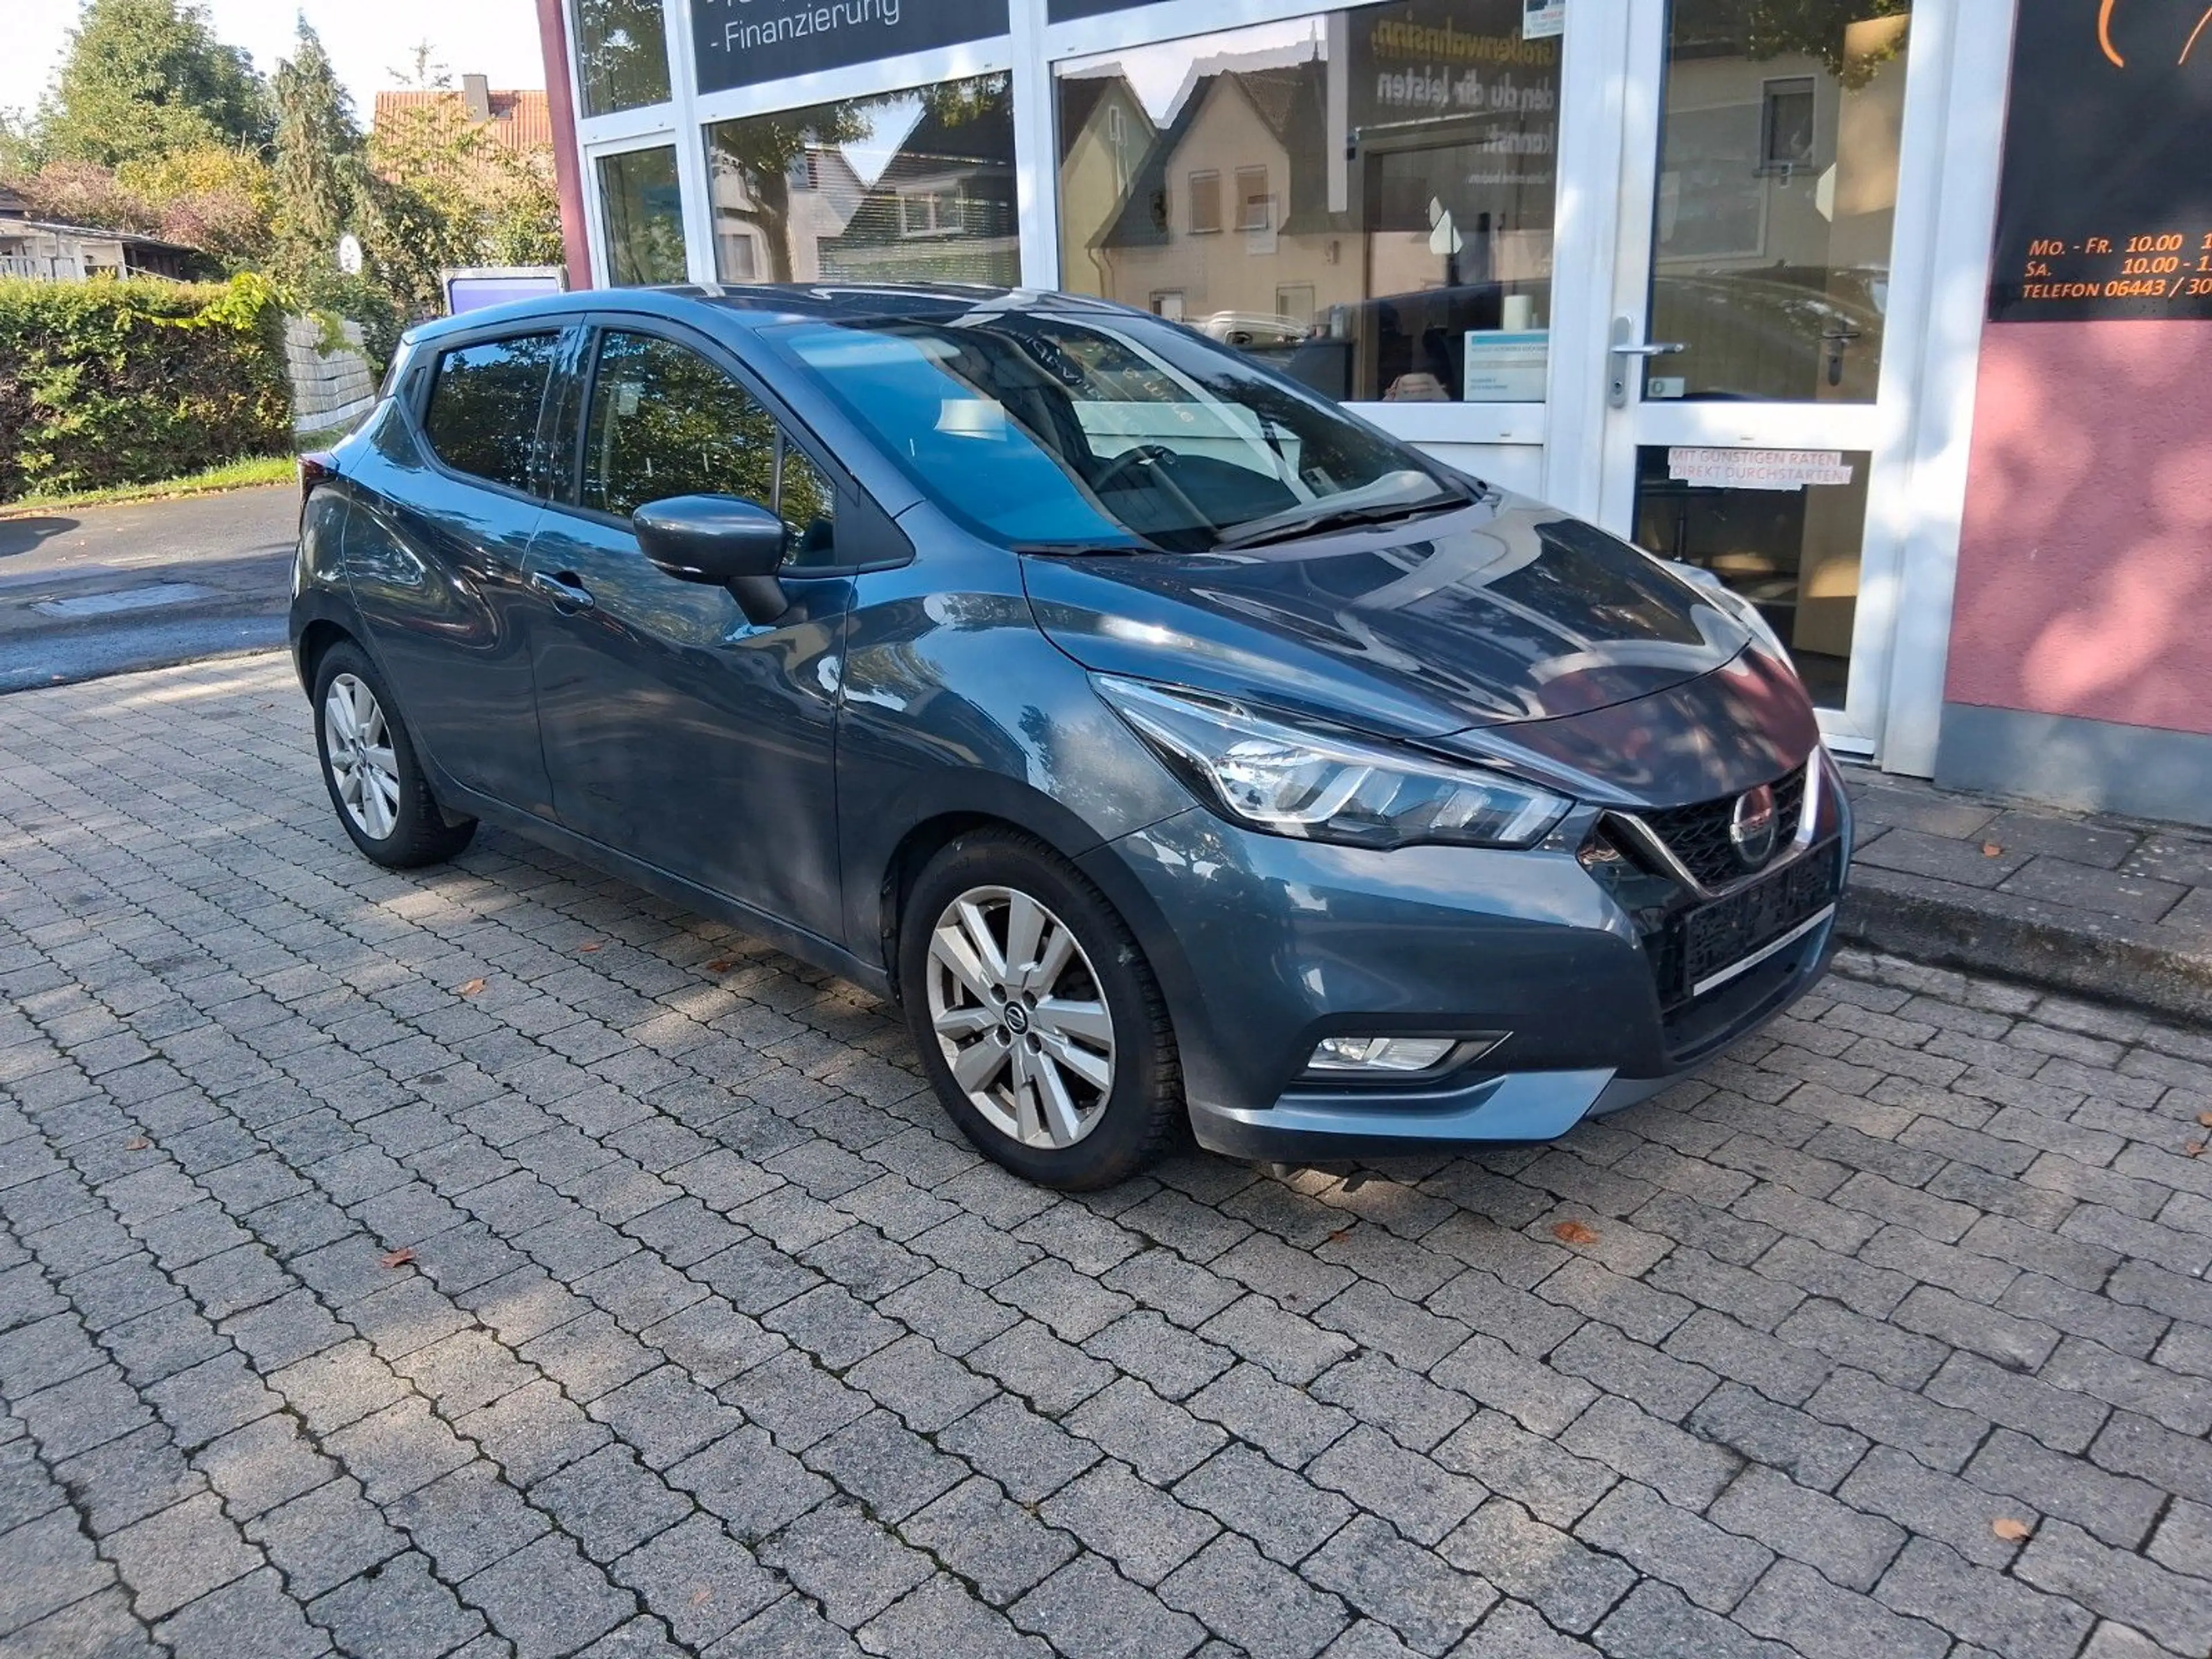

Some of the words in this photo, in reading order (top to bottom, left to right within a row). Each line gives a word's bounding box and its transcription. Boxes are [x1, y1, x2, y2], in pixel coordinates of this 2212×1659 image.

[725, 0, 900, 52] Finanzierung
[2029, 239, 2065, 256] MO.
[2085, 237, 2112, 253] FR.
[2125, 234, 2183, 253] 10.00
[2024, 261, 2052, 277] SA.
[2122, 256, 2179, 275] 10.00
[2022, 283, 2100, 298] TELEFON
[2104, 279, 2166, 297] 06443
[1672, 450, 1696, 461] MIT
[1790, 453, 1838, 466] RATEN
[1673, 465, 1721, 479] DIREKT
